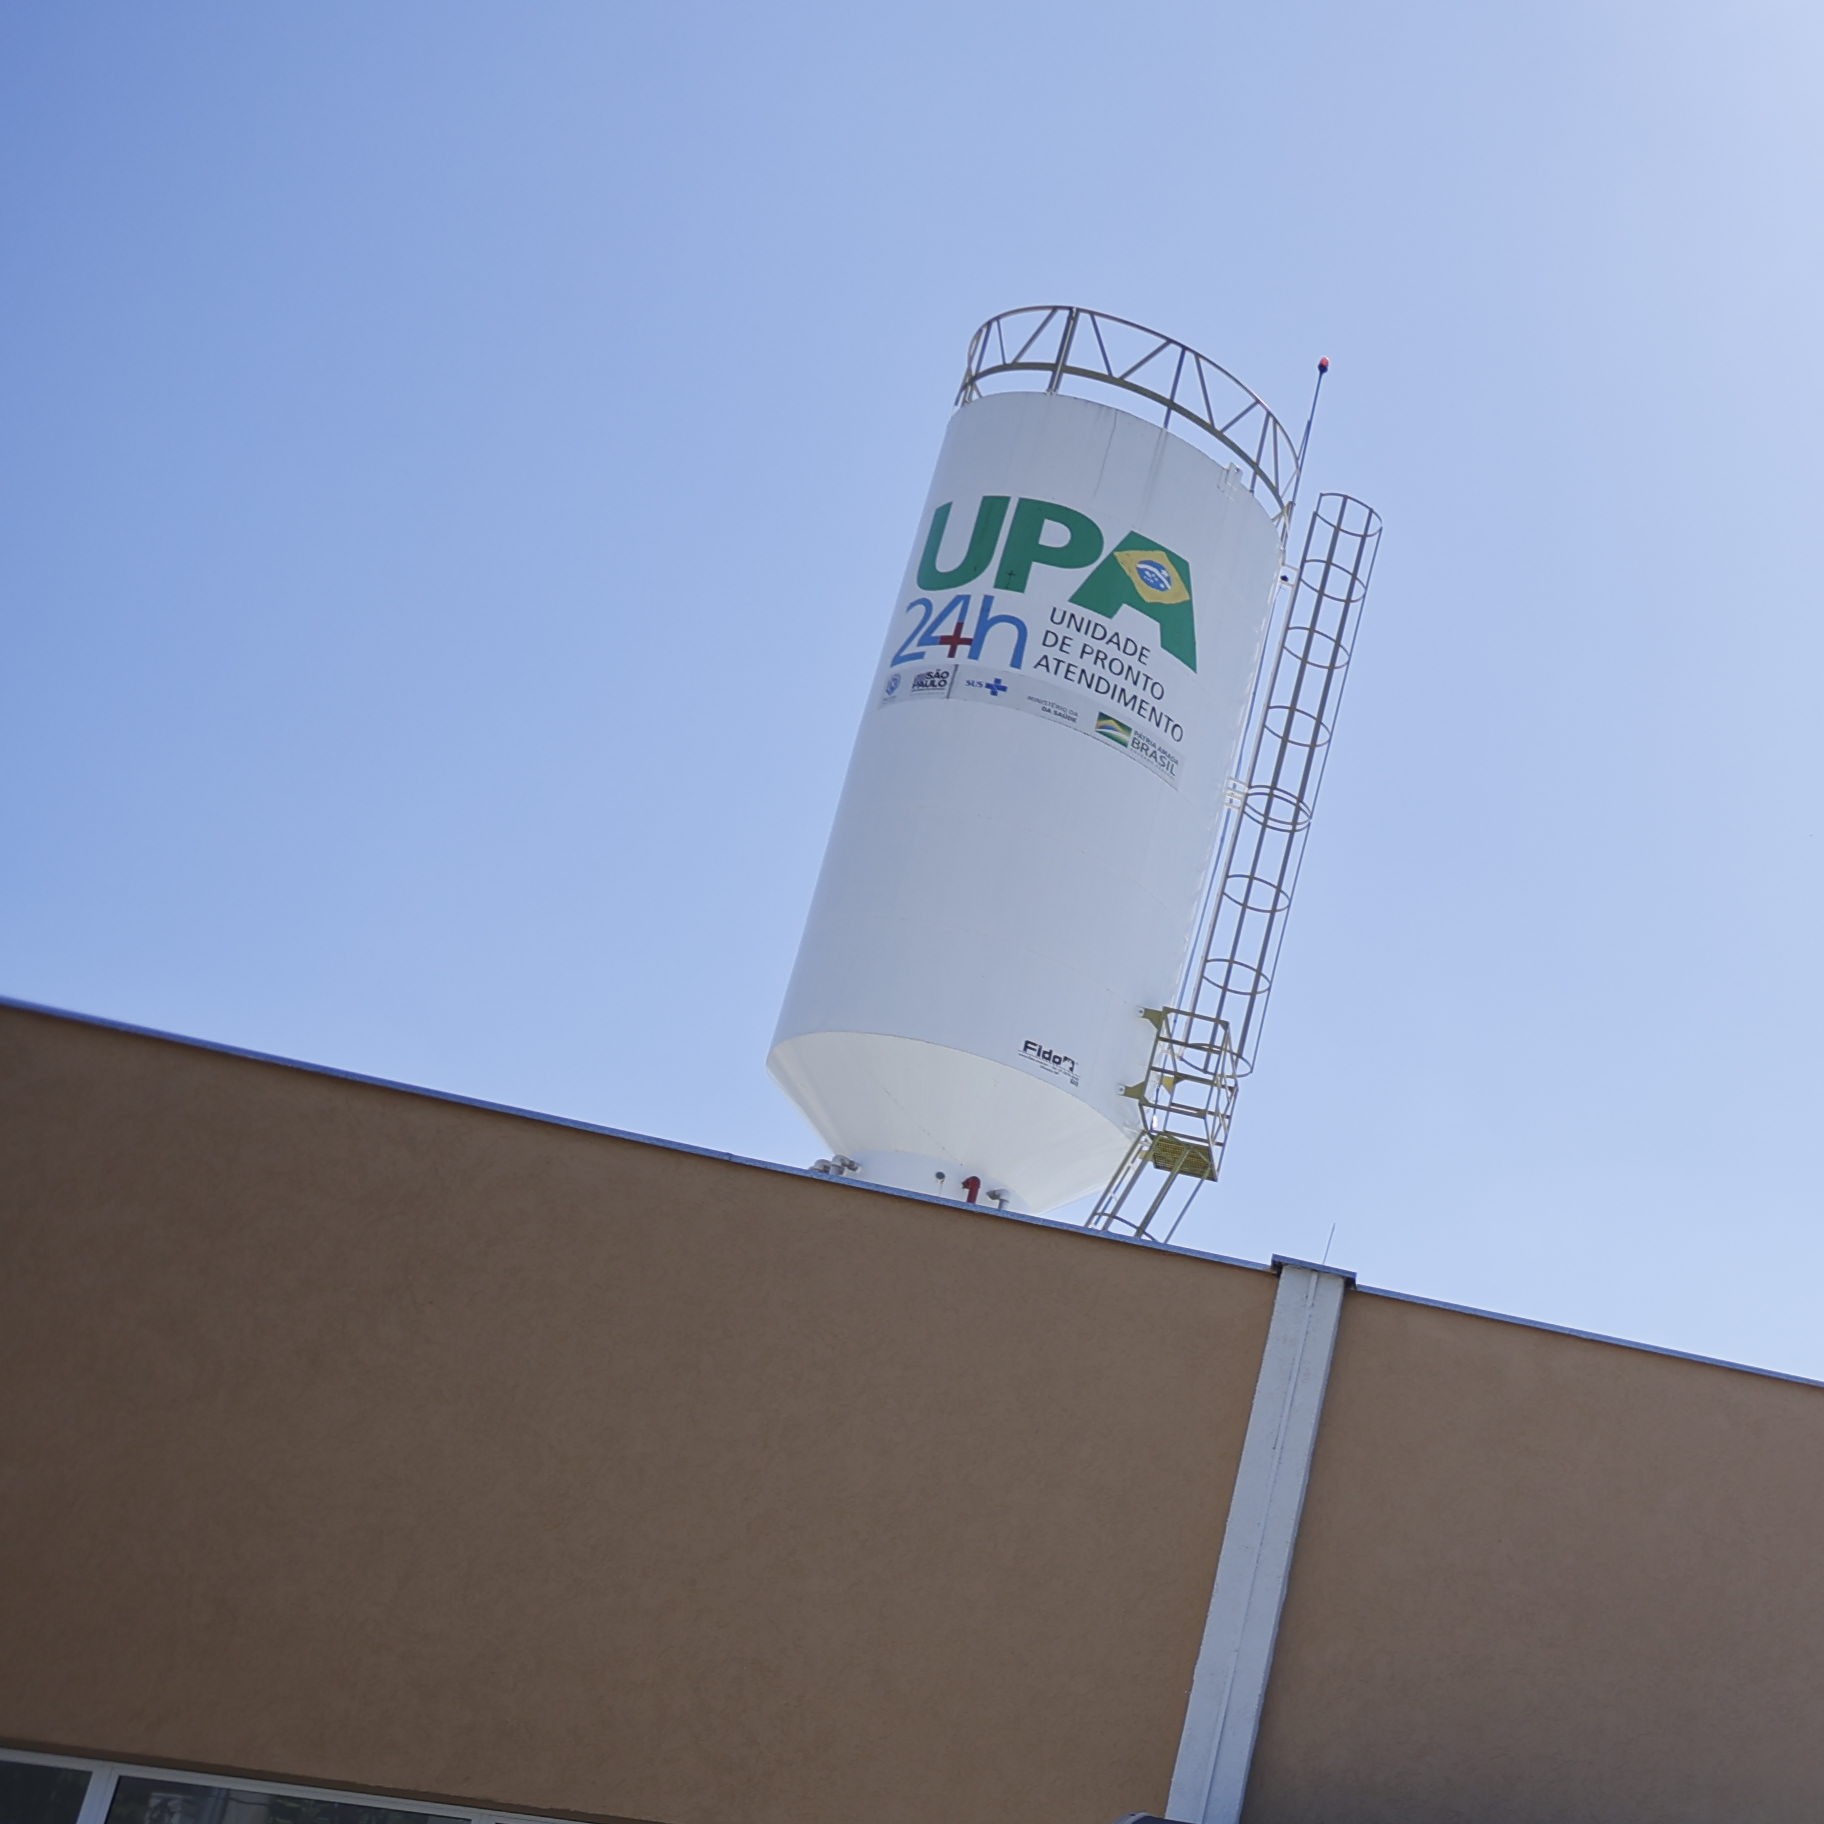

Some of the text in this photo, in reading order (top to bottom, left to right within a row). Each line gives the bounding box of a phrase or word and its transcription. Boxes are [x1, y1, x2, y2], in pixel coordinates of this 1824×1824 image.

[916, 495, 1197, 673] UPA
[890, 594, 1028, 670] 24h
[1050, 606, 1151, 666] UNIDADE
[912, 678, 948, 688] PAULO
[926, 669, 950, 680] SÃO
[1042, 630, 1165, 700] DE PRONTO
[1033, 654, 1184, 742] ATENDIMENTO
[1131, 737, 1176, 776] BRASIL
